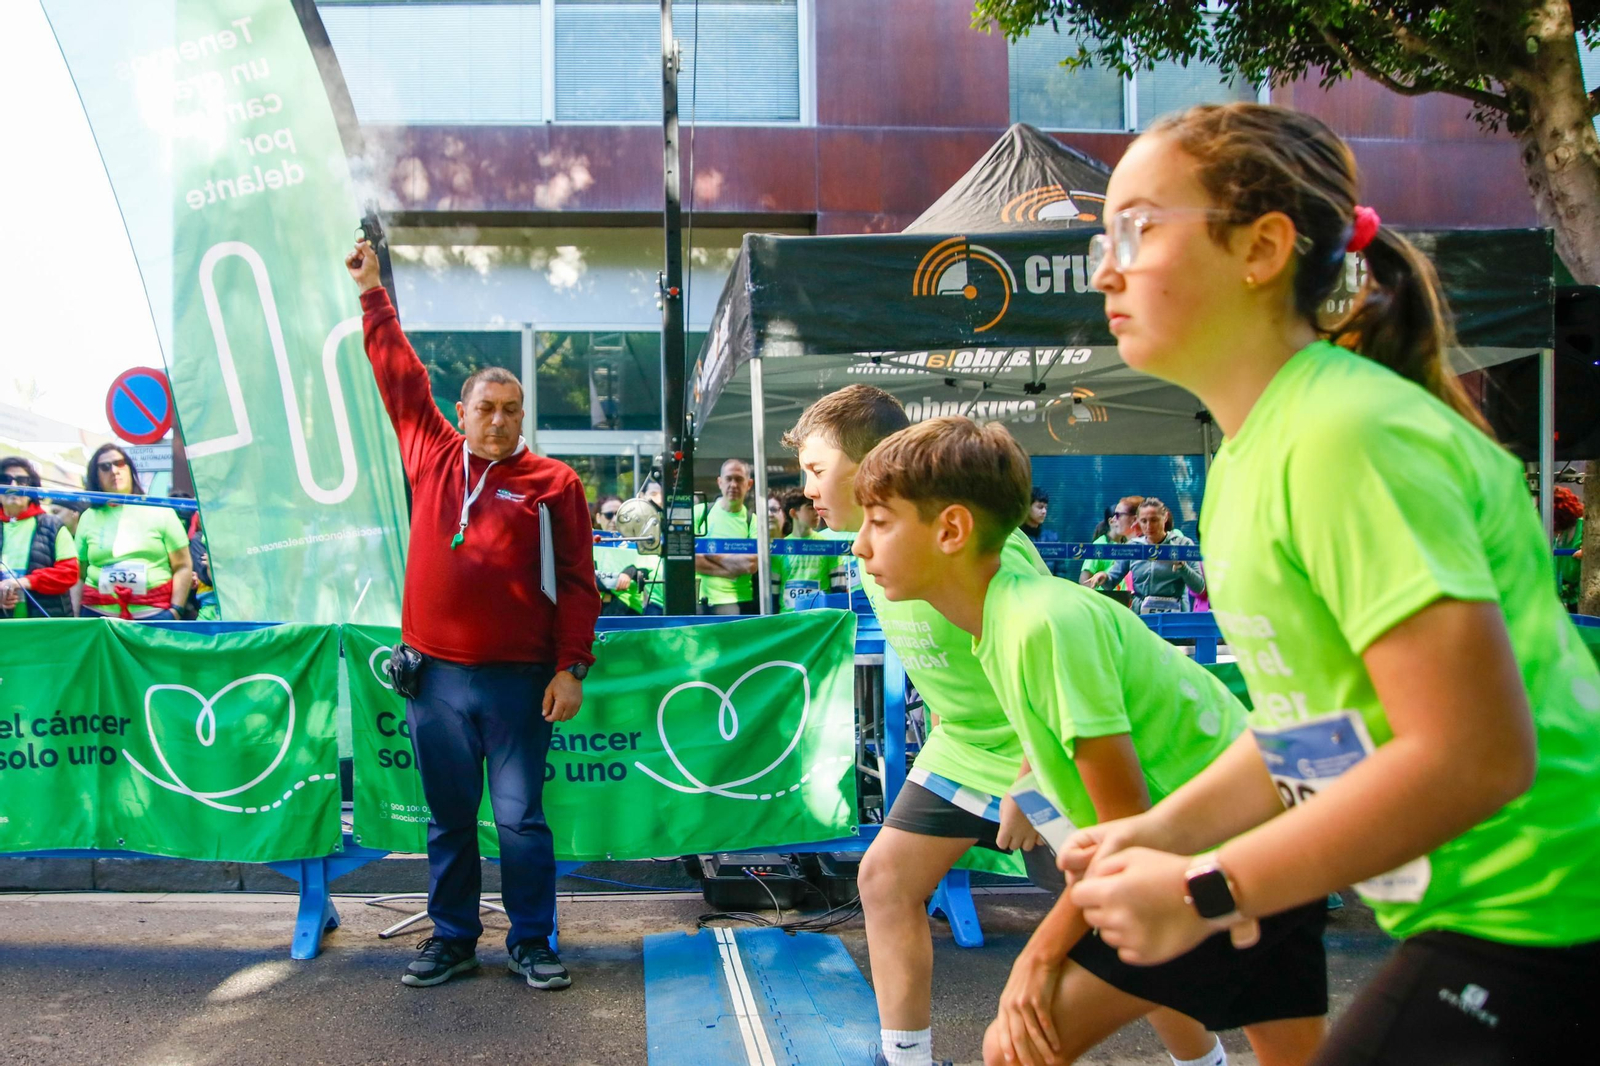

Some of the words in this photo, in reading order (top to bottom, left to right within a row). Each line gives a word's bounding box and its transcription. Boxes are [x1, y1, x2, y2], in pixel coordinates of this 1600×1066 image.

[108, 571, 138, 585] 532
[900, 650, 949, 670] áncer
[31, 709, 131, 738] cáncer
[549, 727, 642, 752] áncer
[68, 744, 117, 766] uno
[565, 761, 627, 782] uno
